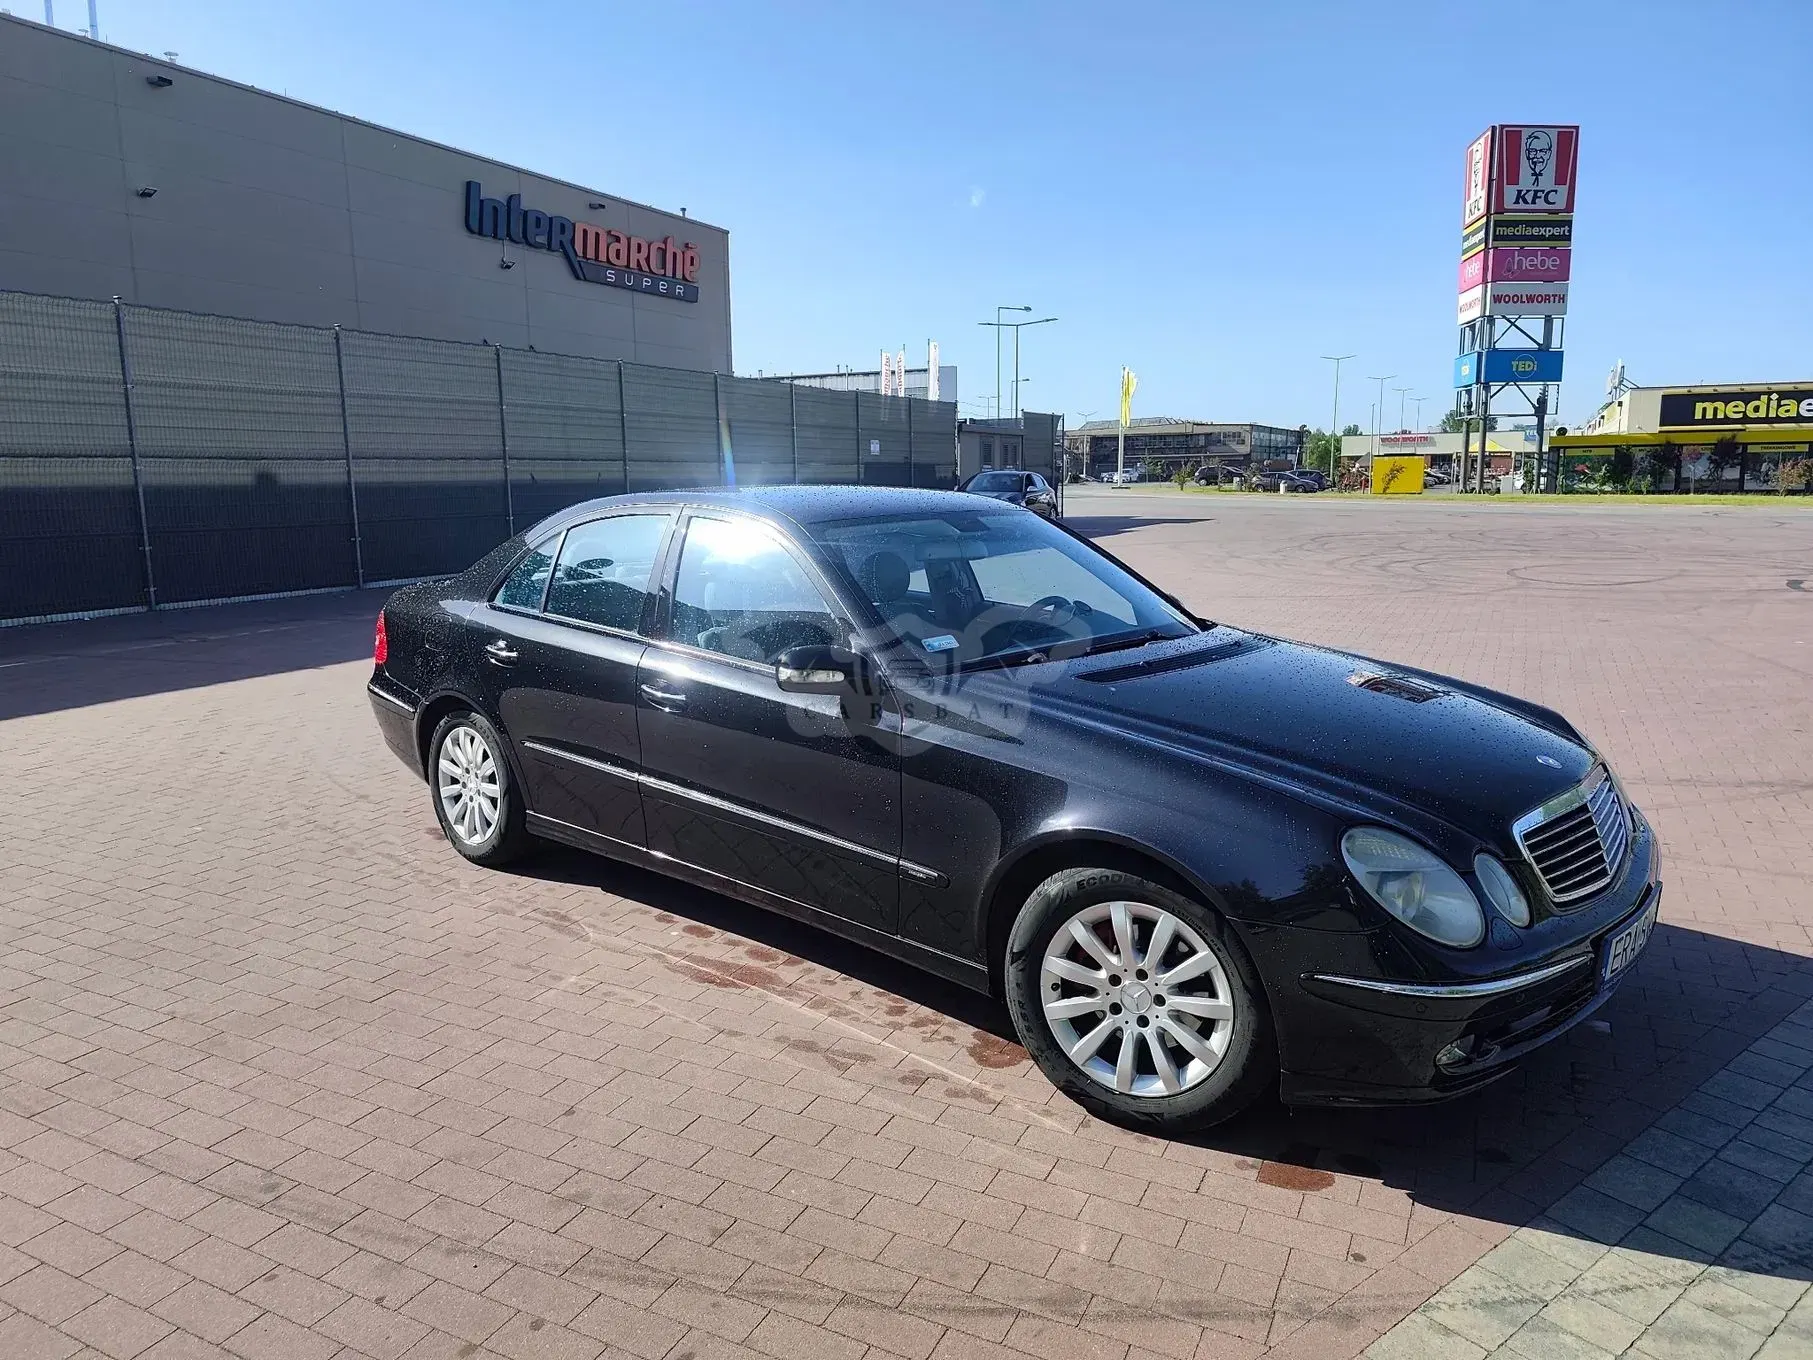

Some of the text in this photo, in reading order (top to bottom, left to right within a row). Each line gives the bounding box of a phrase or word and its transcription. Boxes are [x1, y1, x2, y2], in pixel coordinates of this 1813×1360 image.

[1514, 189, 1559, 206] KFC
[1468, 197, 1482, 218] KFC
[1495, 224, 1570, 238] mediaexpert
[1513, 250, 1561, 271] hebe
[606, 269, 686, 298] SUPER
[1493, 294, 1565, 304] WOOLWORTH
